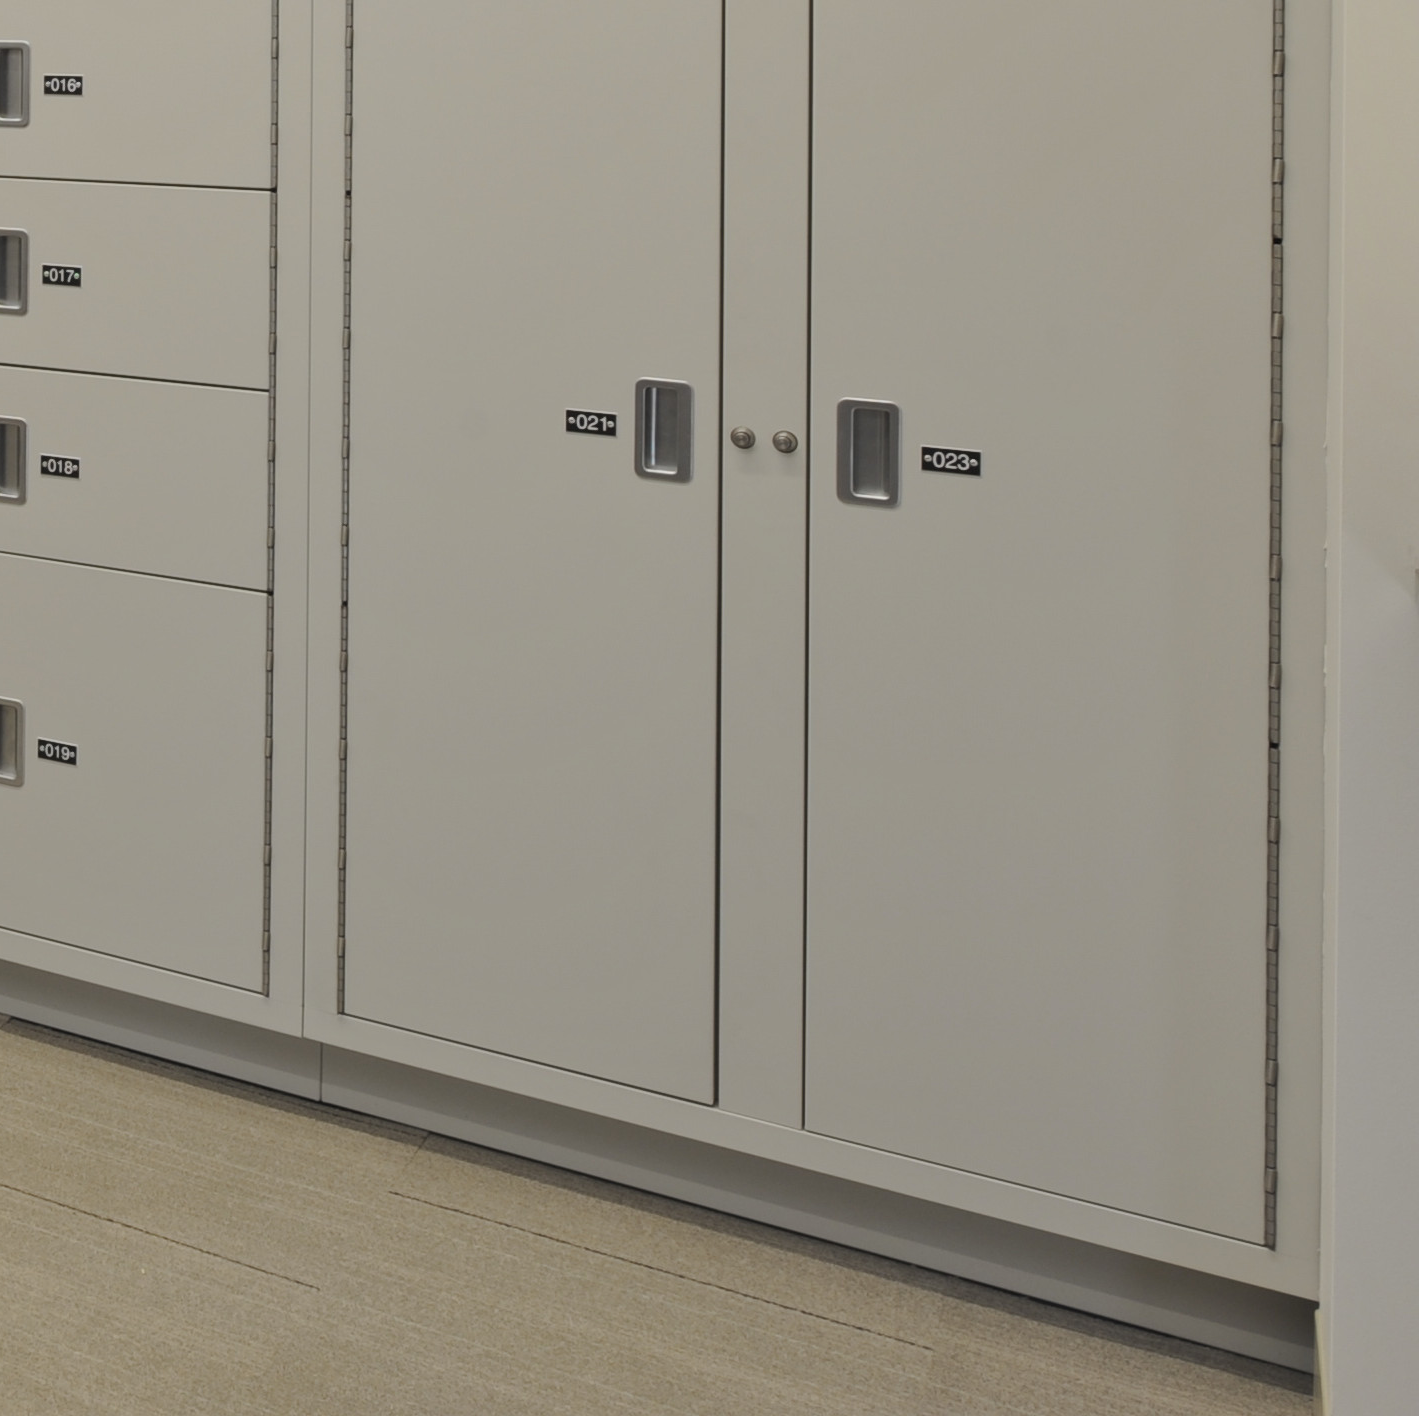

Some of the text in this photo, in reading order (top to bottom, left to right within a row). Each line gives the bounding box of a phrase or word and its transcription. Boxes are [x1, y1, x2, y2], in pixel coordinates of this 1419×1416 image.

[50, 78, 76, 92] 016
[49, 268, 74, 283] 017
[576, 414, 607, 431] 021
[47, 458, 73, 474] 018
[932, 451, 970, 471] 023
[44, 743, 70, 761] 019
